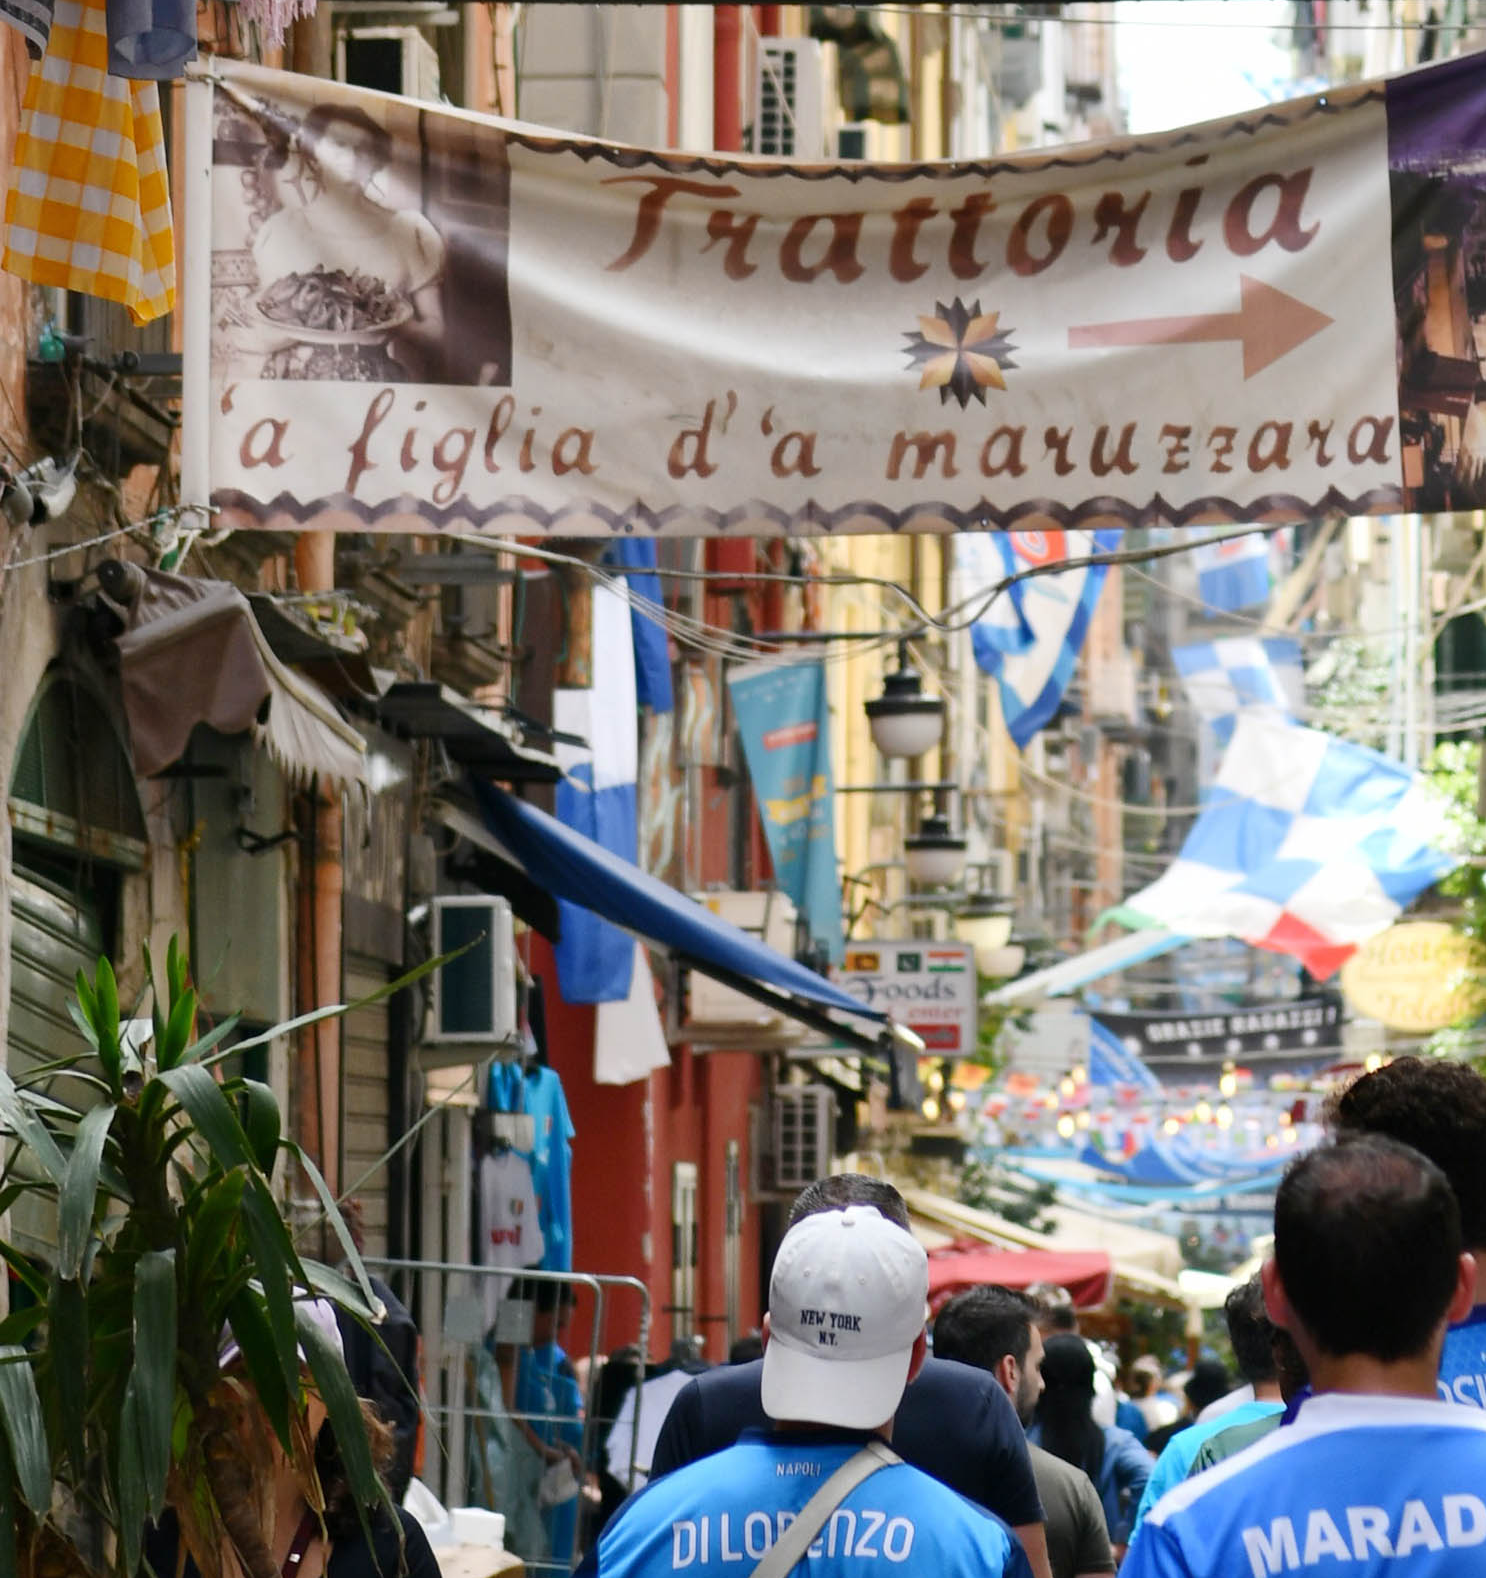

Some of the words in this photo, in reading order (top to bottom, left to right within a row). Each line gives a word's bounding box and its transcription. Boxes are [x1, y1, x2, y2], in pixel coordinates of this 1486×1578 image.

[602, 154, 1321, 287] Trattoria
[345, 387, 602, 505] figlia
[886, 407, 1402, 480] maruzzara
[846, 974, 957, 1005] Foods
[801, 1310, 826, 1326] NEW
[830, 1312, 862, 1333] YORK
[819, 1330, 838, 1347] N.Y.
[776, 1461, 822, 1478] NAPOLI
[672, 1516, 710, 1569] DI
